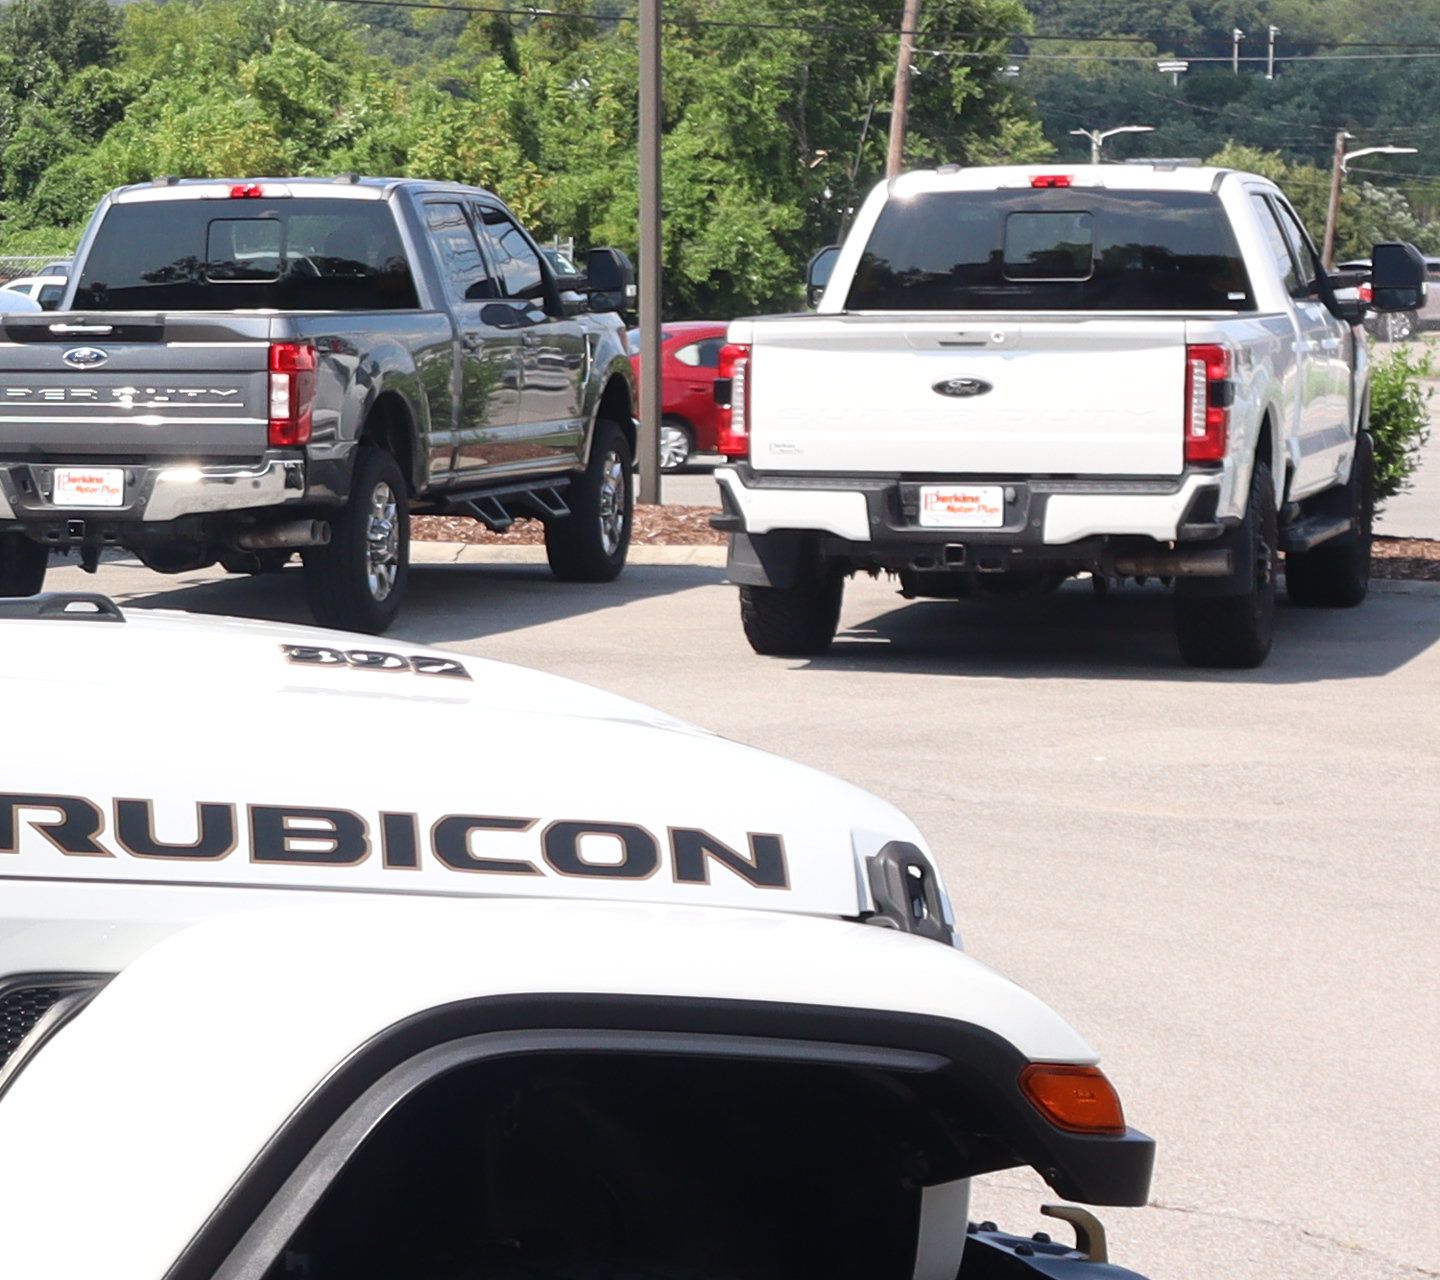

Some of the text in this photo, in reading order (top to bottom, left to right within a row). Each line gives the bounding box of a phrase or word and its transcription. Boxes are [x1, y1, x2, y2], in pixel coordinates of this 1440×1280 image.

[945, 380, 981, 394] Ford
[59, 473, 104, 487] Perkins
[925, 493, 980, 507] Perkins
